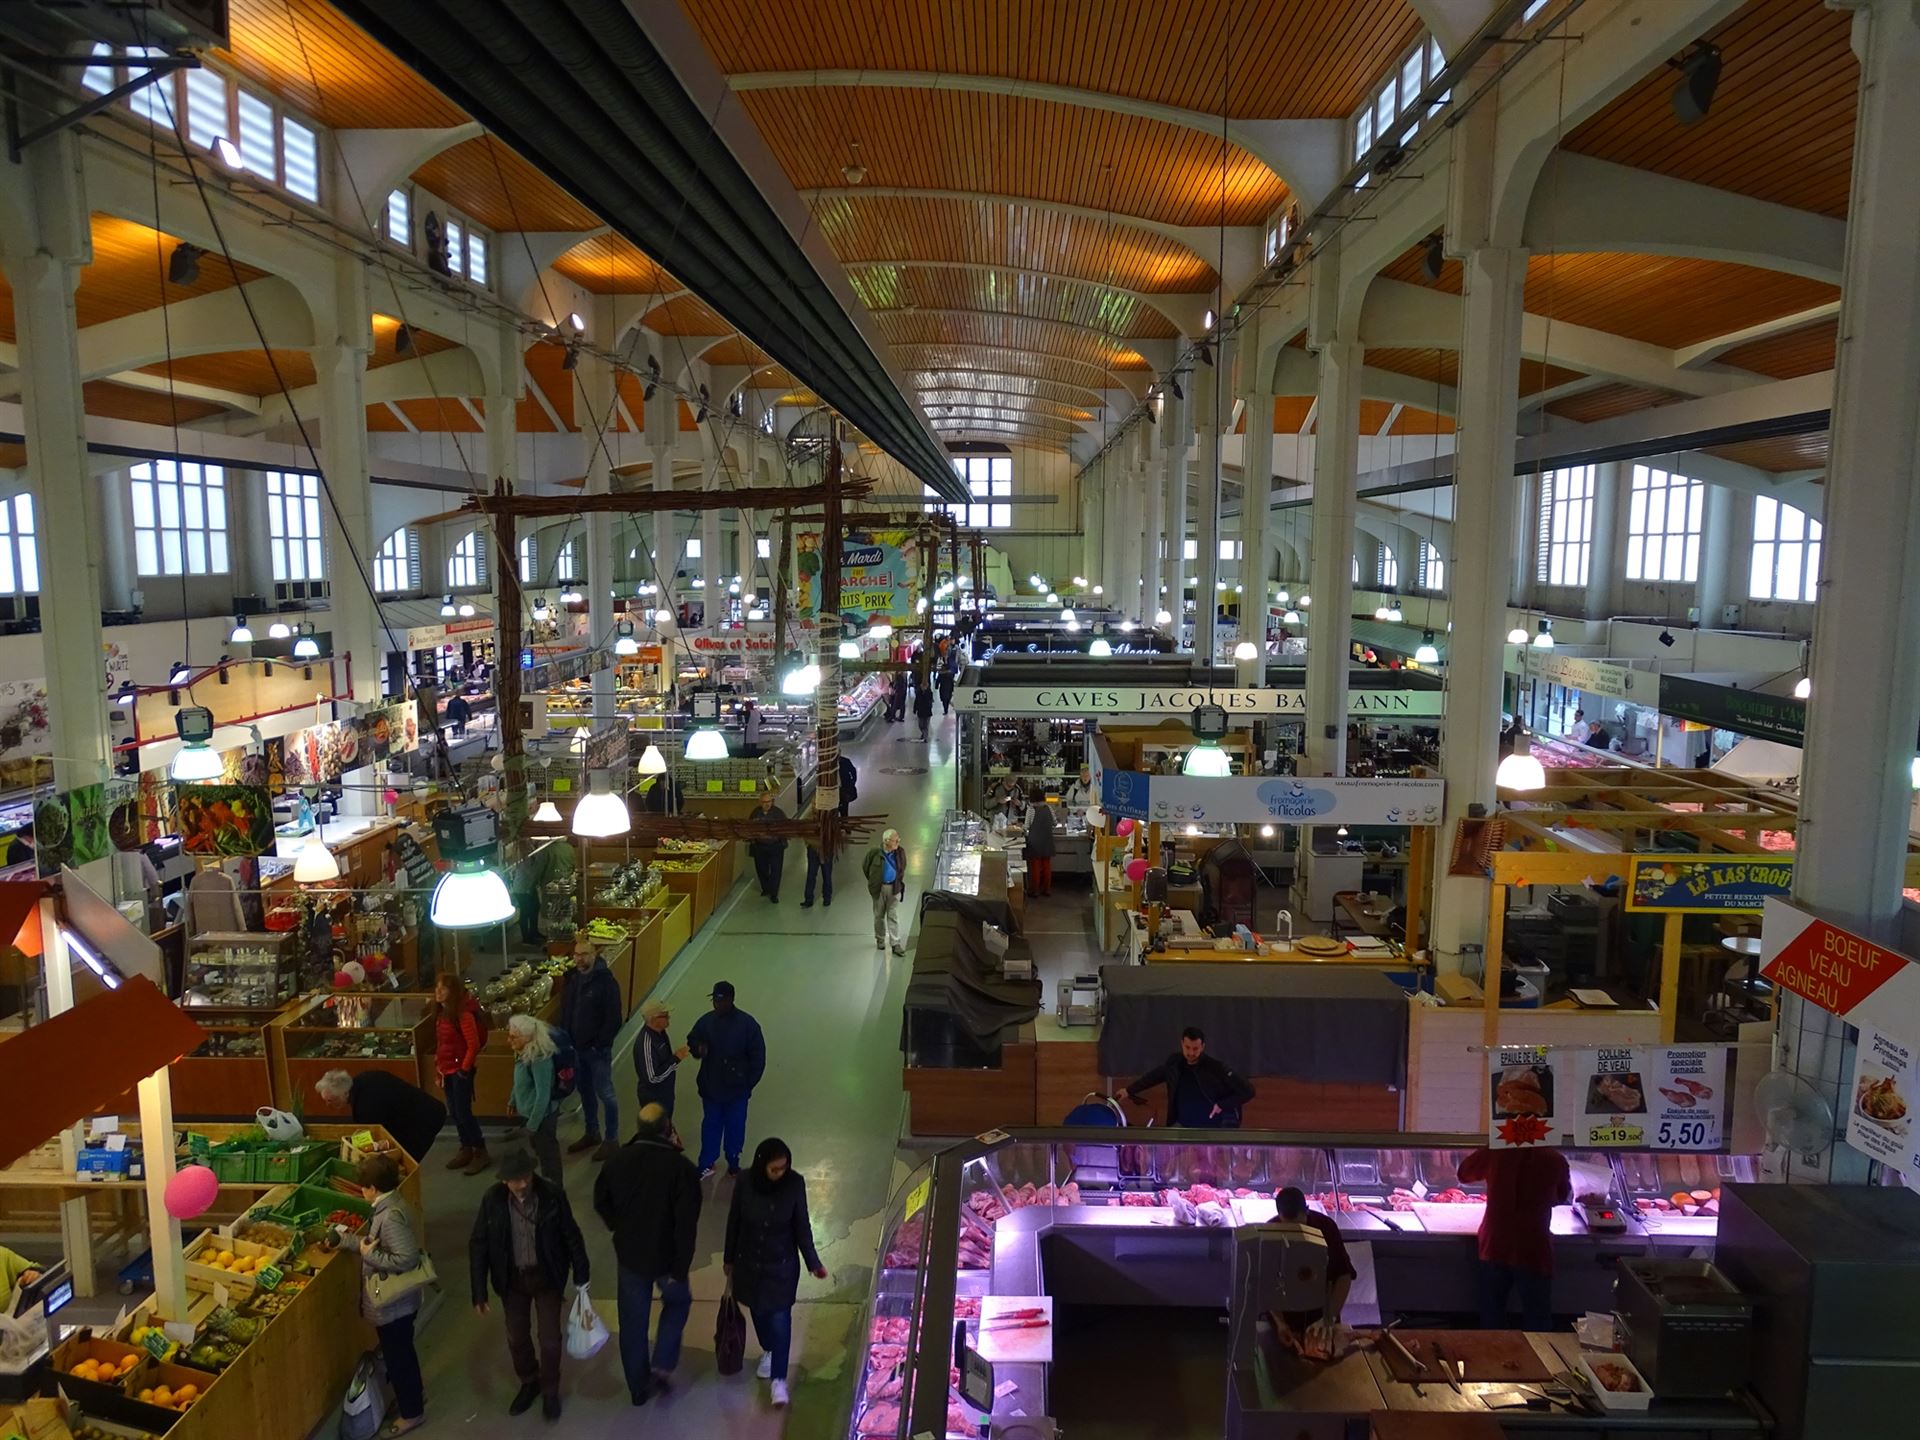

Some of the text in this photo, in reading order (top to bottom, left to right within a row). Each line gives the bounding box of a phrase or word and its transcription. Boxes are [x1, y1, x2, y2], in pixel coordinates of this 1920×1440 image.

[847, 550, 882, 565] Mardi
[864, 595, 887, 608] PRIX
[694, 638, 726, 650] Olives
[1036, 692, 1411, 710] CAVES JACQUES BAANN
[1270, 795, 1315, 806] fromagerie
[1278, 804, 1317, 817] Nicolas
[1685, 874, 1710, 896] LE
[1824, 930, 1882, 971] BOEUF
[1809, 949, 1851, 987] VEAU
[1776, 961, 1838, 1009] AGNEAU
[1597, 1049, 1632, 1059] COLLIER
[1667, 1050, 1707, 1059] Promotion
[1873, 1043, 1907, 1069] Printemps
[1597, 1061, 1631, 1071] DE VEAU
[1658, 1122, 1705, 1148] 5,50
